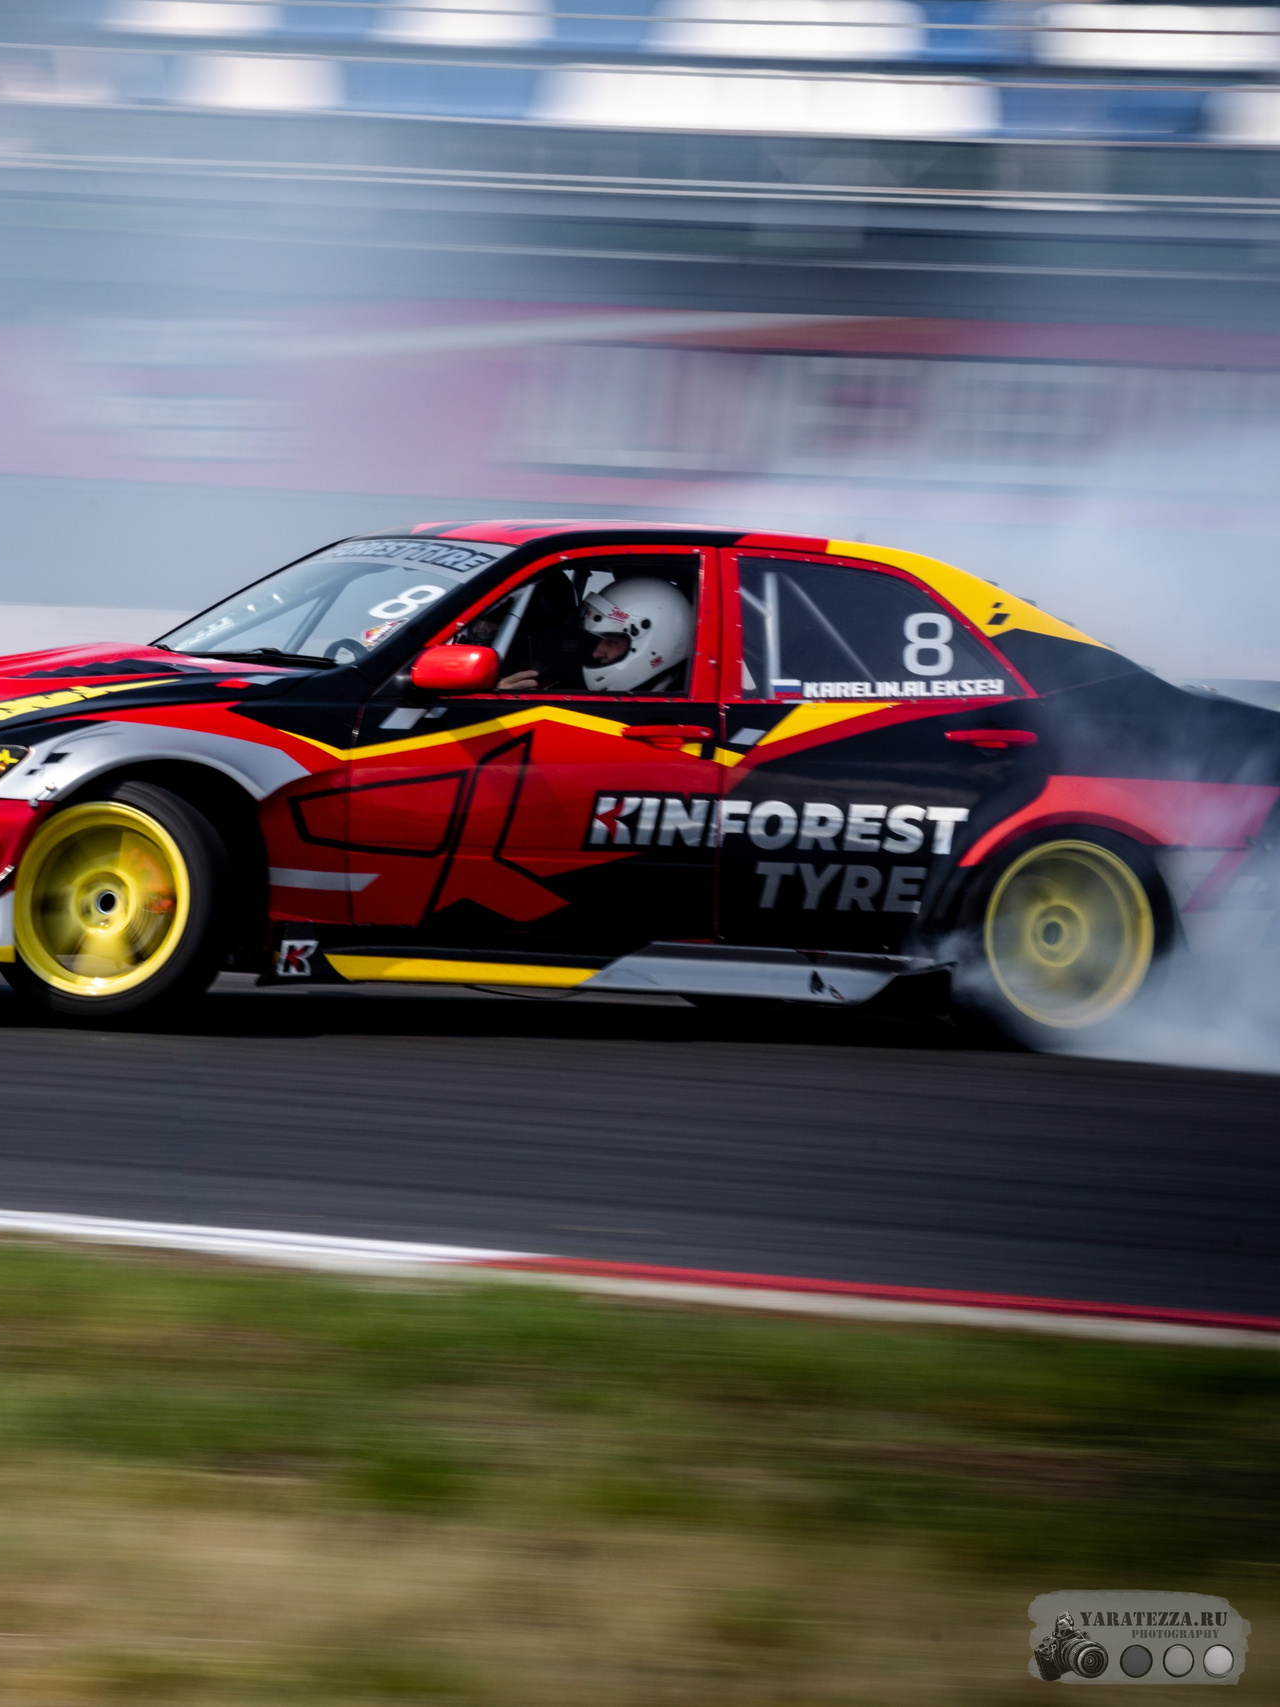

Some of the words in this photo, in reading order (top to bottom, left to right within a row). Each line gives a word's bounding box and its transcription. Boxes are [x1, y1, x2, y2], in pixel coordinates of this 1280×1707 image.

[418, 543, 501, 573] TYRE
[367, 584, 447, 620] 8
[902, 612, 954, 677] 8
[802, 678, 1005, 699] KARELIN.ALEKSEY
[588, 796, 970, 855] KINFOREST
[754, 861, 928, 914] TYRE
